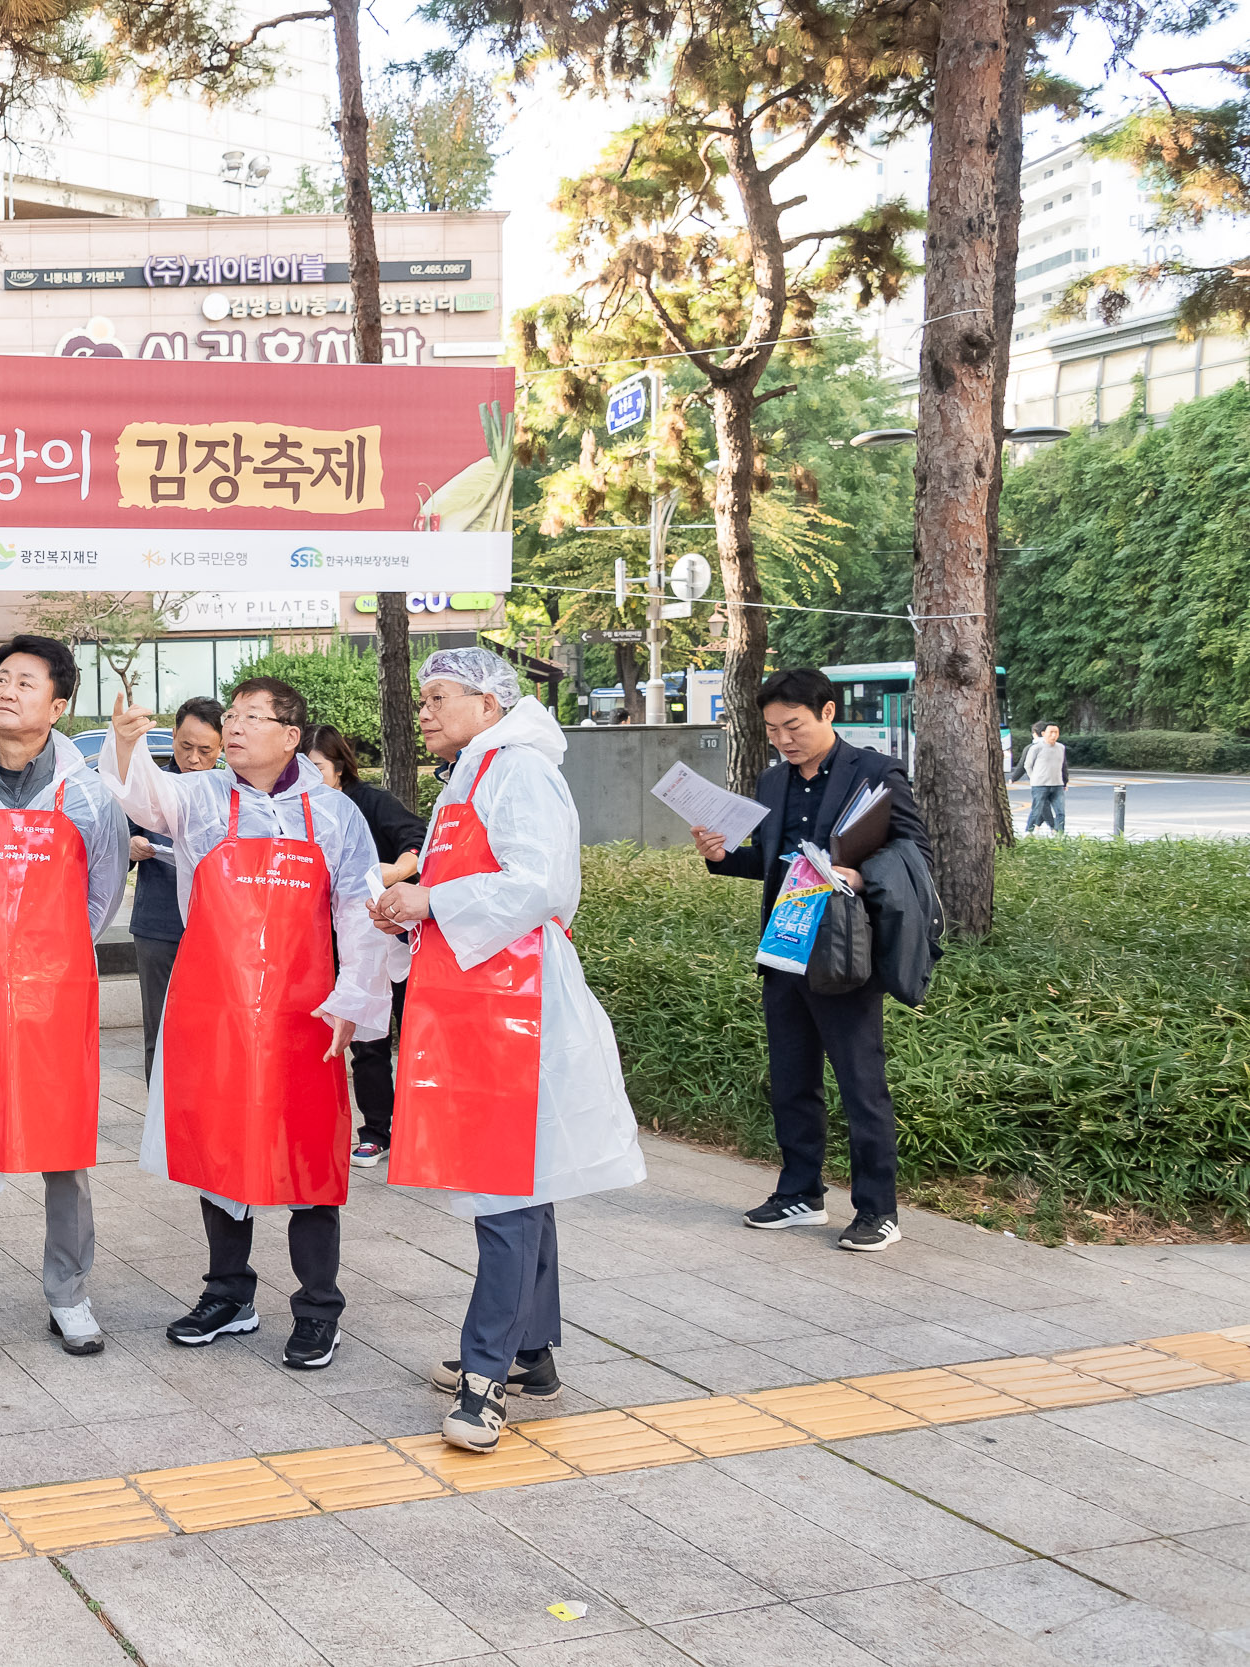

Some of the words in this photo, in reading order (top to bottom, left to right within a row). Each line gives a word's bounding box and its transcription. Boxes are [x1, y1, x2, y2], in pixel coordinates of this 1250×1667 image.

[143, 254, 326, 287] (주)제이테이블
[409, 264, 466, 276] 02.465.0987
[136, 431, 366, 504] 김장축제
[20, 550, 98, 565] 광진복지재단
[326, 555, 409, 568] 한국사회보장정보원
[196, 602, 237, 614] WHY
[246, 599, 330, 613] PILATES
[405, 591, 448, 613] CU
[706, 739, 717, 748] 10
